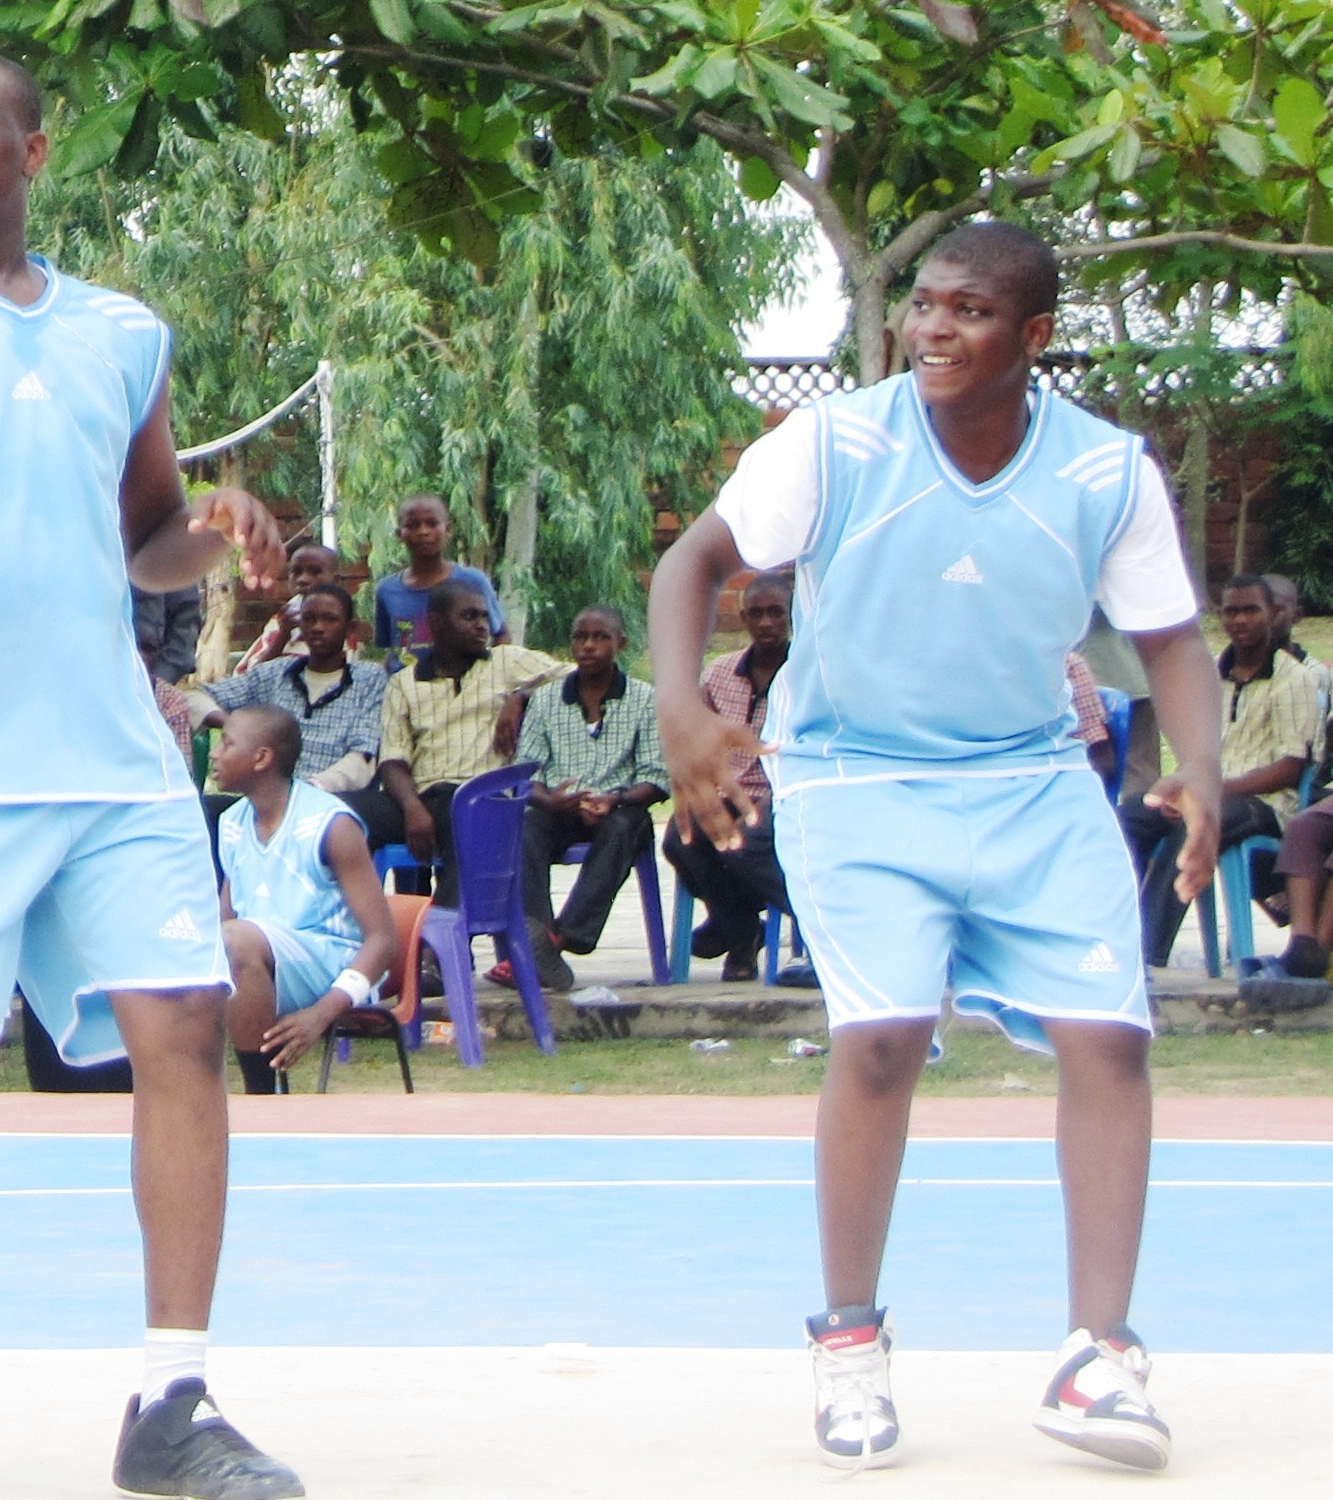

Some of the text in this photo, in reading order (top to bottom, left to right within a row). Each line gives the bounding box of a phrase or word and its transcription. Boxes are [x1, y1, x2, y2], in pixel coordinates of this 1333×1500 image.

[940, 570, 983, 585] adidas
[158, 927, 203, 942] adidas
[1077, 961, 1122, 973] adidas
